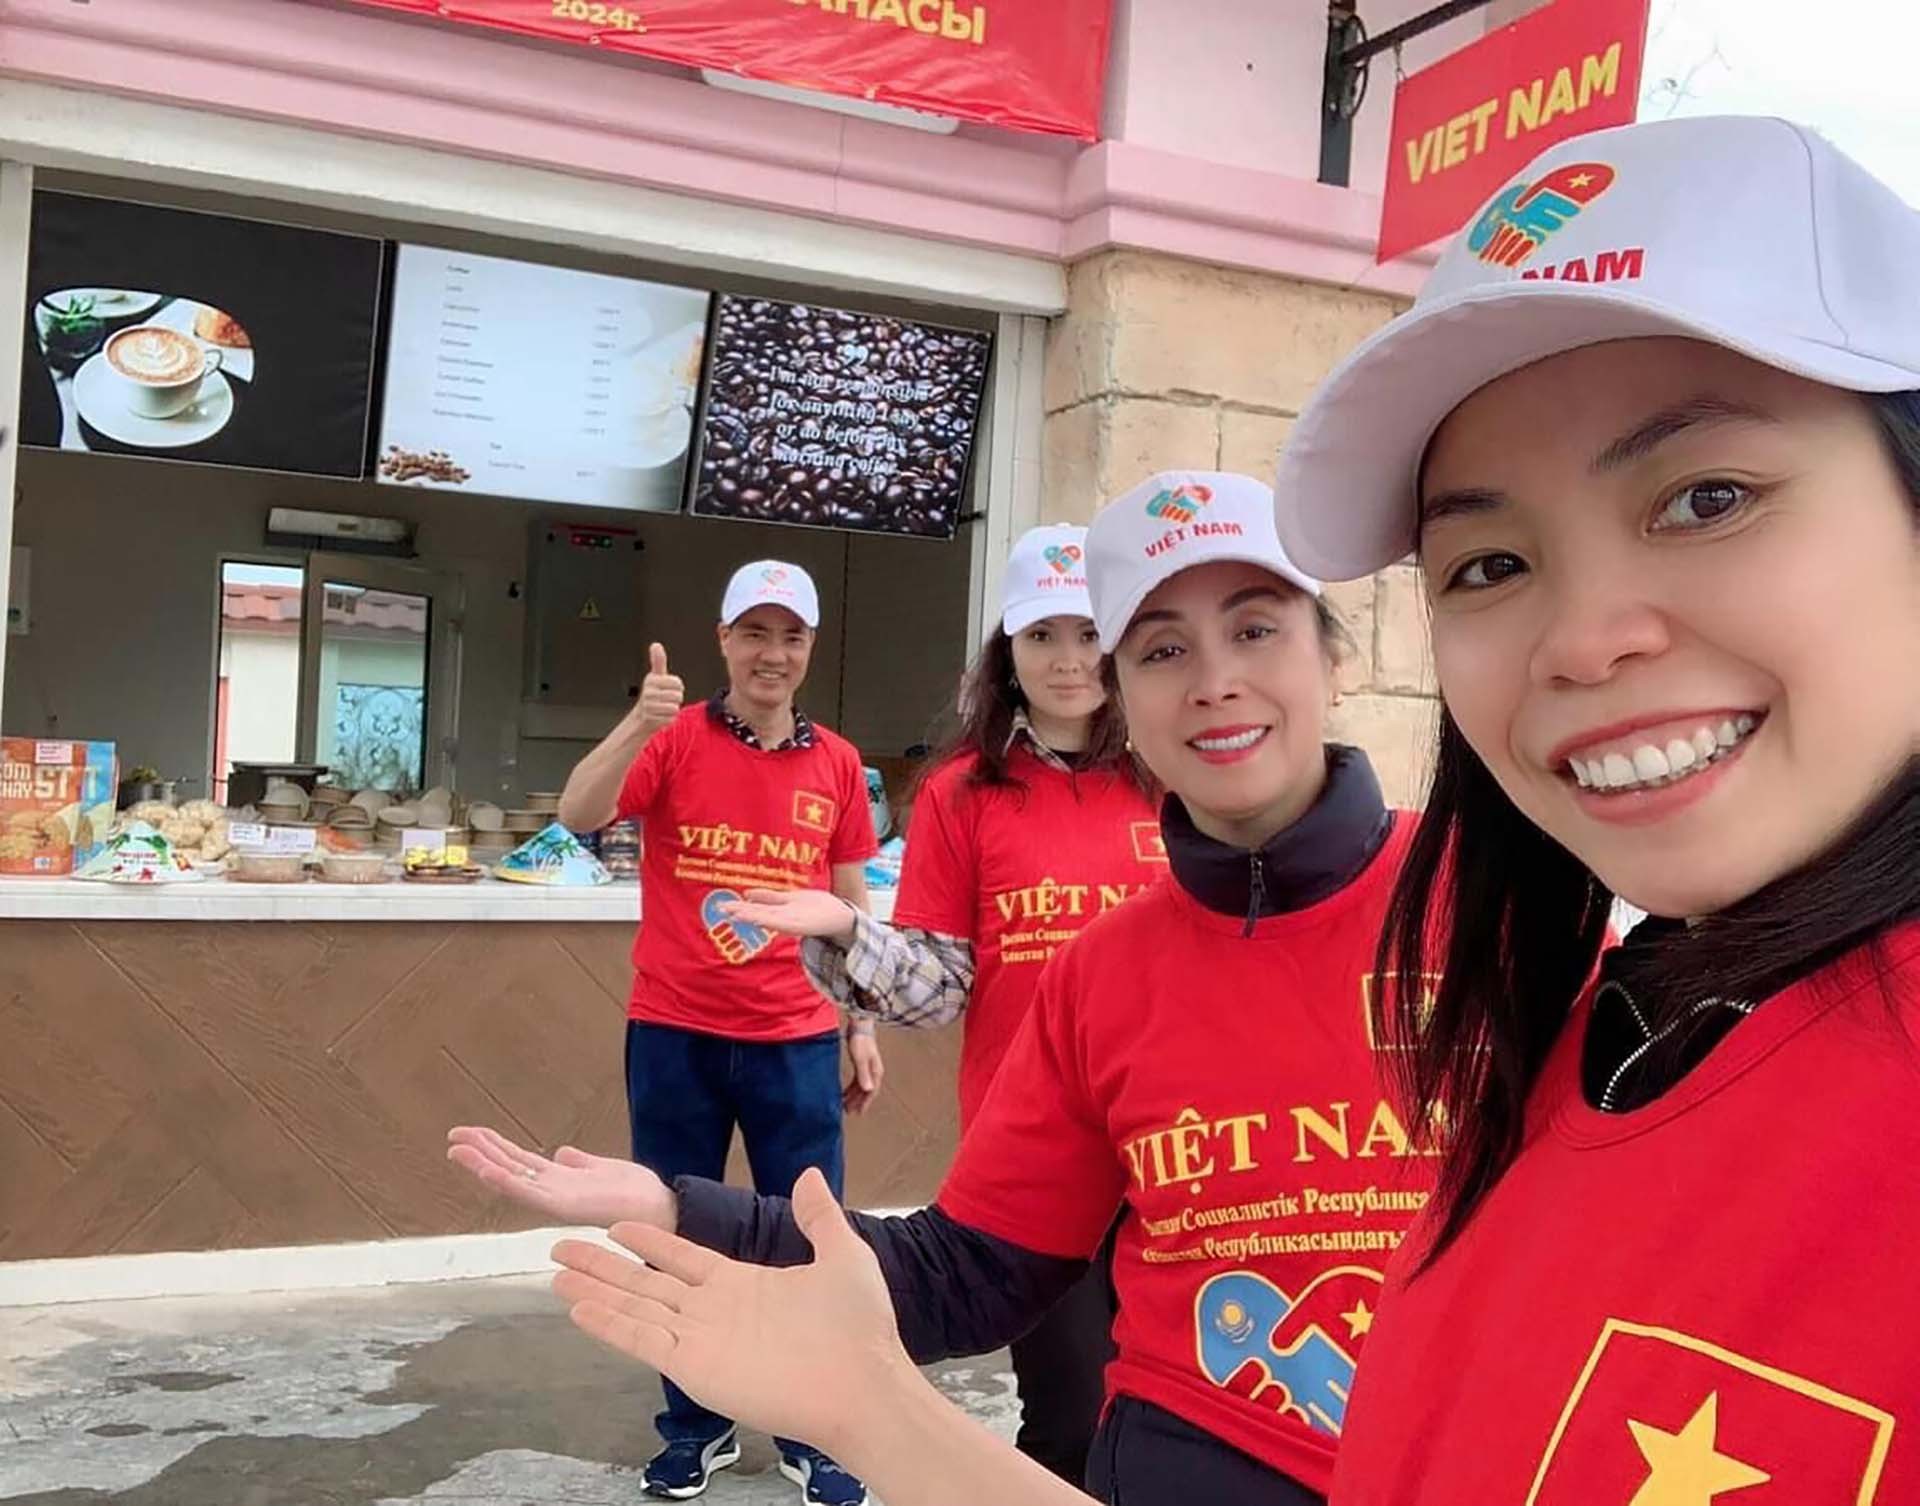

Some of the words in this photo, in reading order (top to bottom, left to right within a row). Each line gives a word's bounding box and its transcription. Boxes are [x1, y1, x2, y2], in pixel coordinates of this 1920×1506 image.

[1406, 97, 1499, 184] VIET
[1505, 41, 1622, 140] NAM
[1192, 522, 1244, 537] NAM
[677, 823, 754, 856] VIỆT
[757, 834, 822, 865] NAM
[996, 877, 1089, 923] VIỆT
[1124, 1107, 1268, 1195] VIỆT
